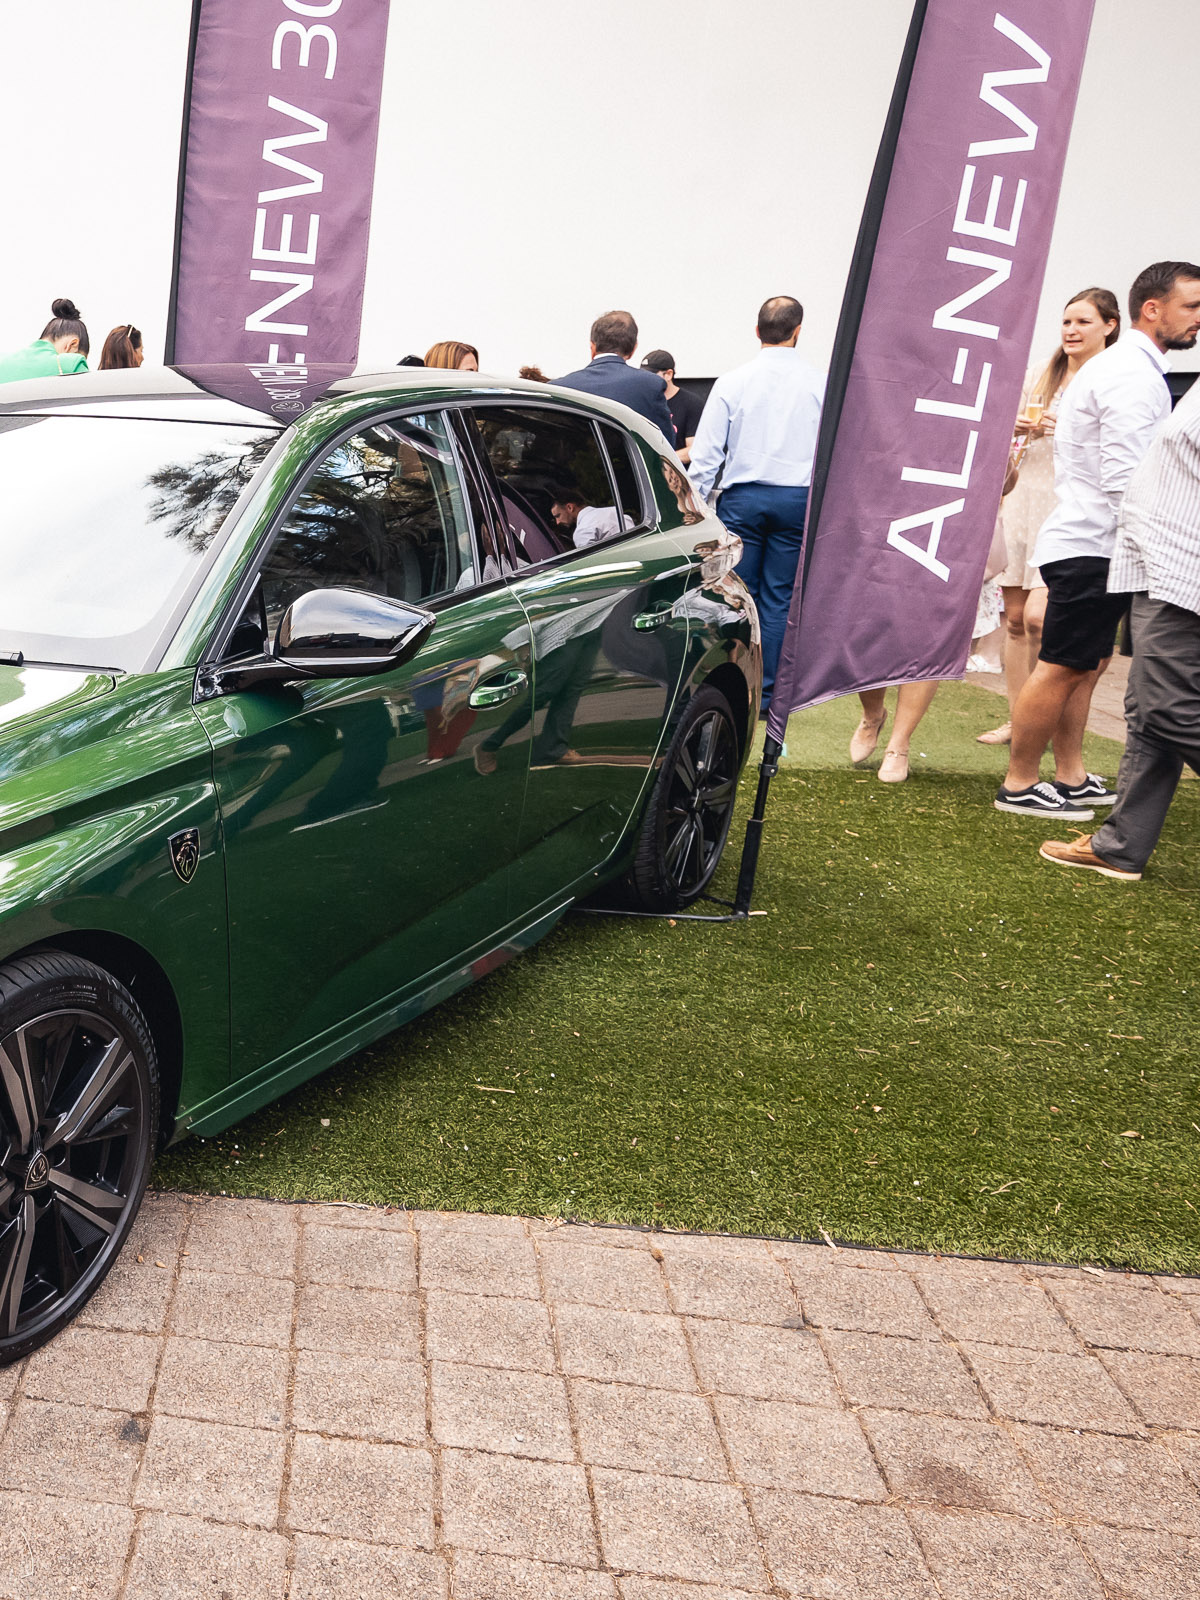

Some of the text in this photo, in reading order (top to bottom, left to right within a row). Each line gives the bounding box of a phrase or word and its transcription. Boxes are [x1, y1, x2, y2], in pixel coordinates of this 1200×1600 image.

[271, 0, 343, 80] 3
[244, 95, 328, 363] -NEW
[886, 13, 1051, 582] ALL-NEW
